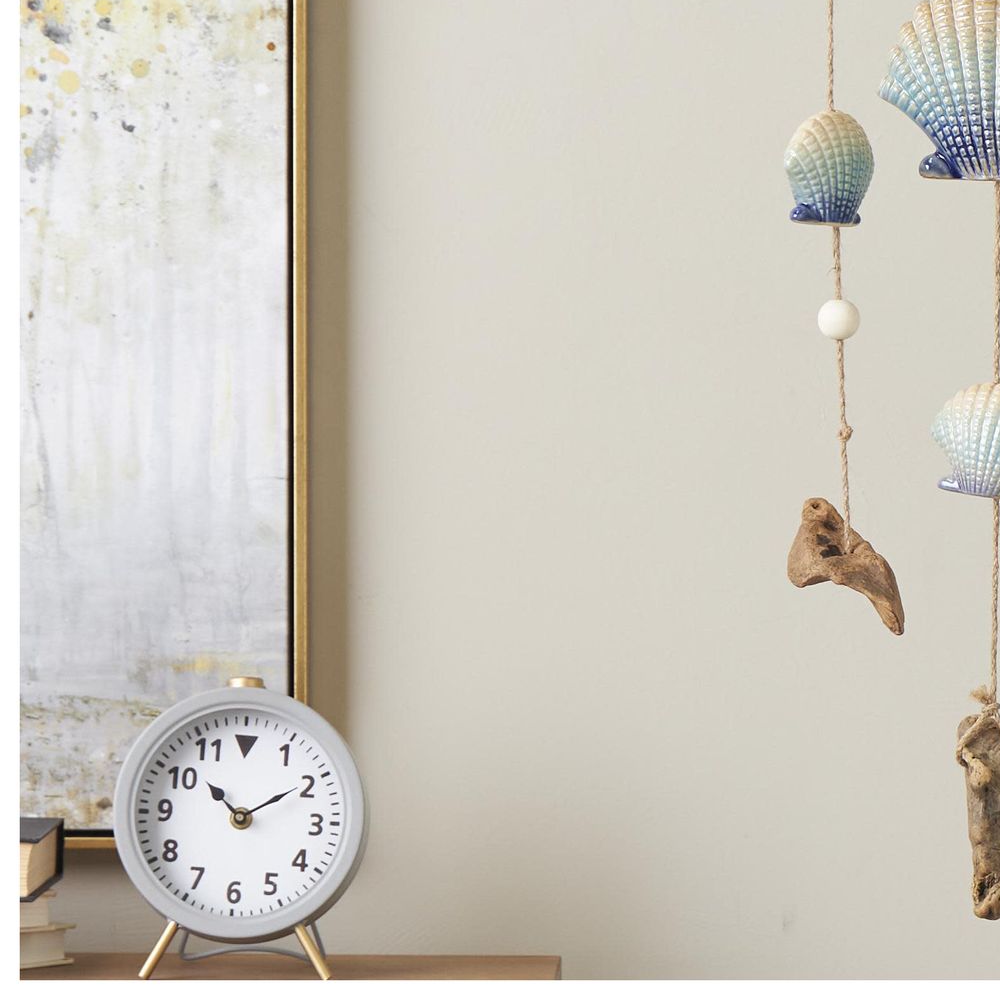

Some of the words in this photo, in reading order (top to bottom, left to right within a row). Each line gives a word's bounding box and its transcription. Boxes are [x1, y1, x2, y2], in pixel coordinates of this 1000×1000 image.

[195, 737, 222, 762] 11
[279, 743, 290, 767] 1
[168, 765, 198, 790] 10
[299, 774, 315, 798] 2
[157, 798, 173, 822] 9
[308, 813, 324, 836] 3
[161, 838, 178, 863] 8
[291, 849, 309, 873] 4
[190, 866, 205, 890] 7
[263, 872, 279, 896] 5
[226, 881, 242, 904] 6
